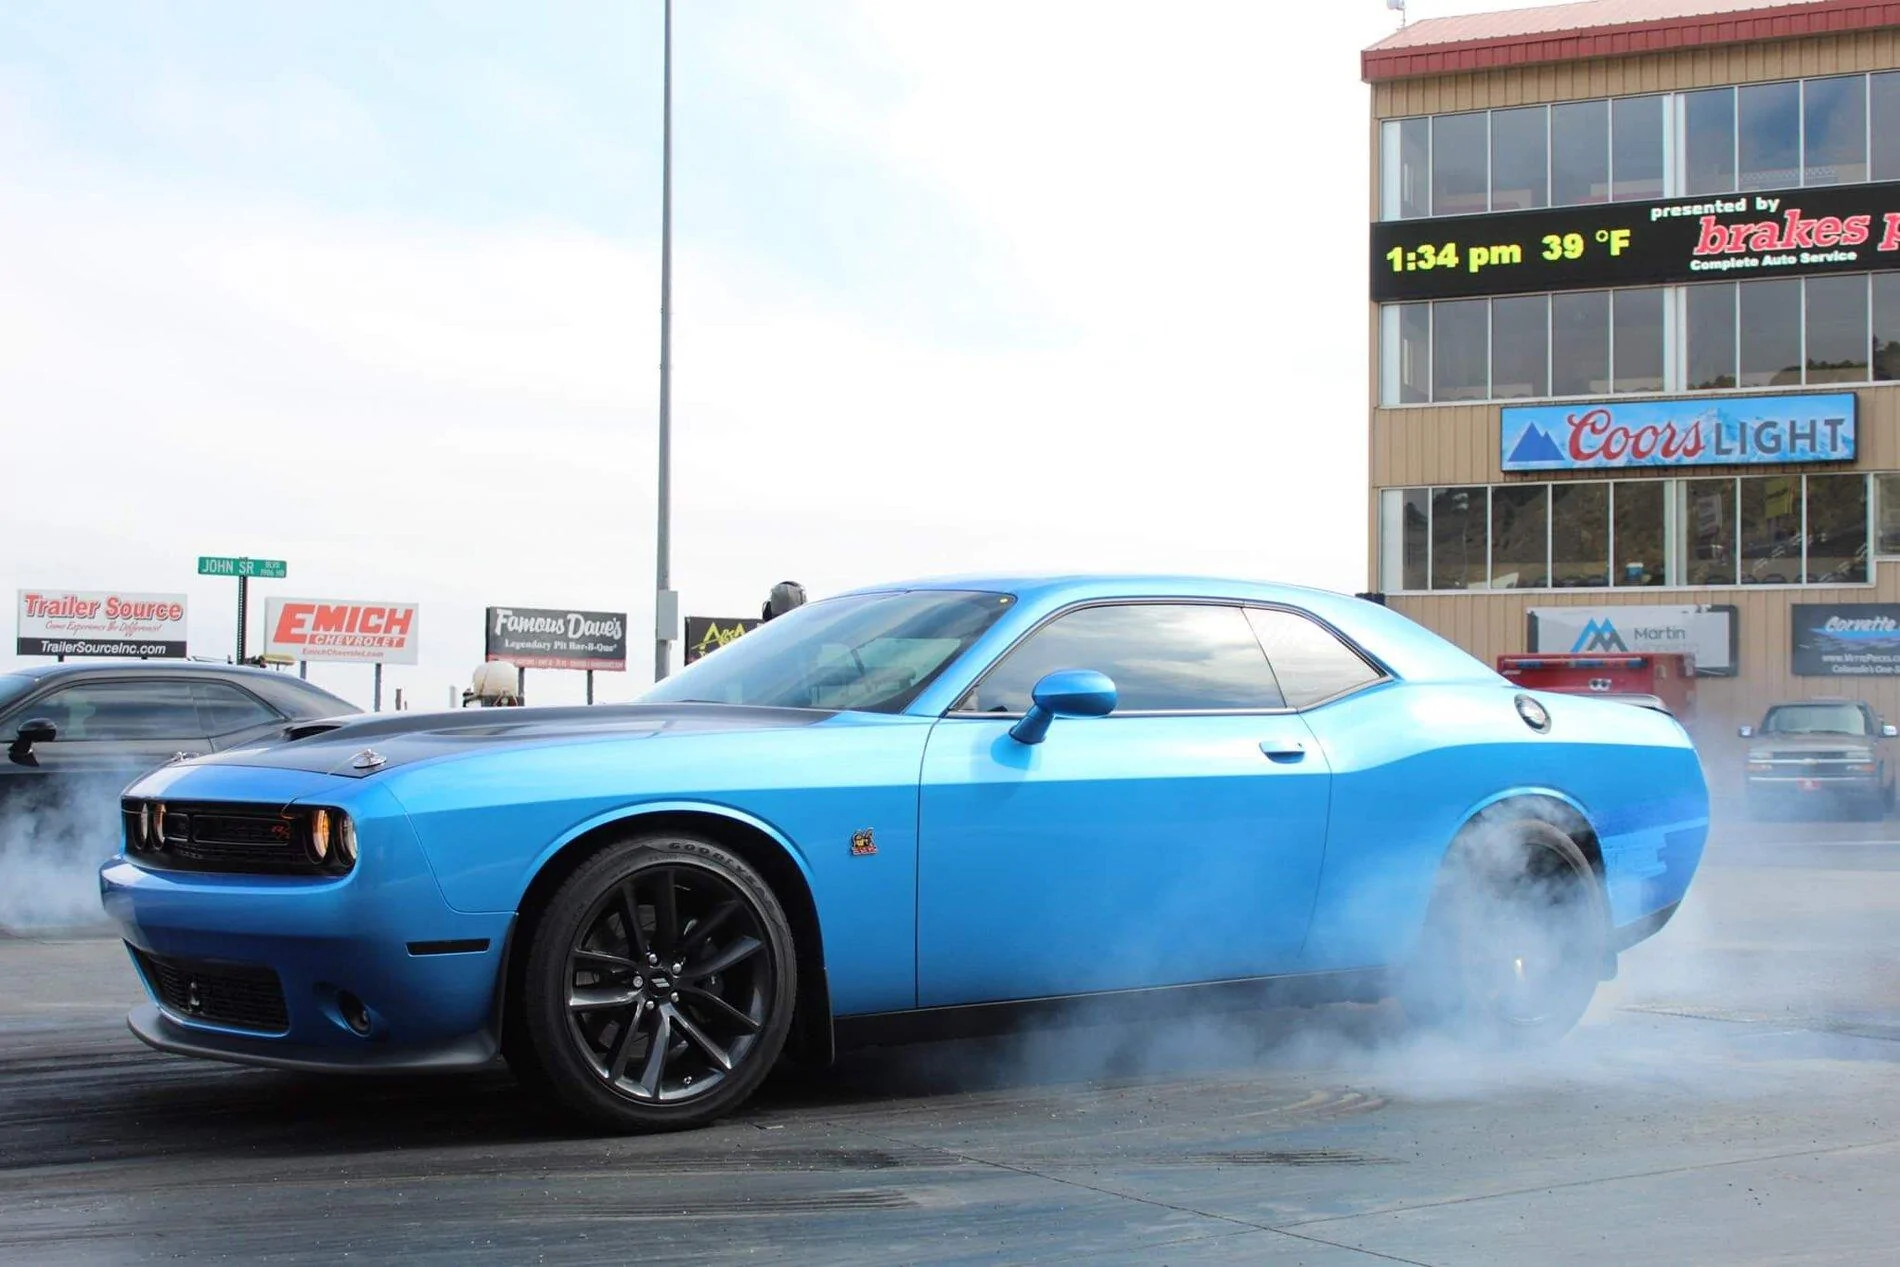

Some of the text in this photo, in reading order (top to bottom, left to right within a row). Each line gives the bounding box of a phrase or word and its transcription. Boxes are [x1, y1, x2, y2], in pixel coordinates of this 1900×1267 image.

[1650, 197, 1780, 221] presented by
[1693, 208, 1871, 256] brakes
[1386, 229, 1631, 273] 1:34 pm 39 °F
[1690, 250, 1858, 272] Complete Auto Service
[1567, 409, 1846, 461] Coors LIGHT
[202, 559, 234, 573] JOHN
[239, 561, 254, 575] SR
[25, 594, 184, 621] Trailer Source
[273, 603, 414, 644] EMICH
[495, 608, 622, 640] Famous Dave's
[1634, 627, 1686, 640] Martin
[1824, 616, 1897, 632] Corvette
[41, 641, 166, 655] TrailerSourceInc.com
[315, 635, 401, 648] CHEVROLET
[504, 638, 552, 651] Legendary
[554, 640, 567, 650] Pit
